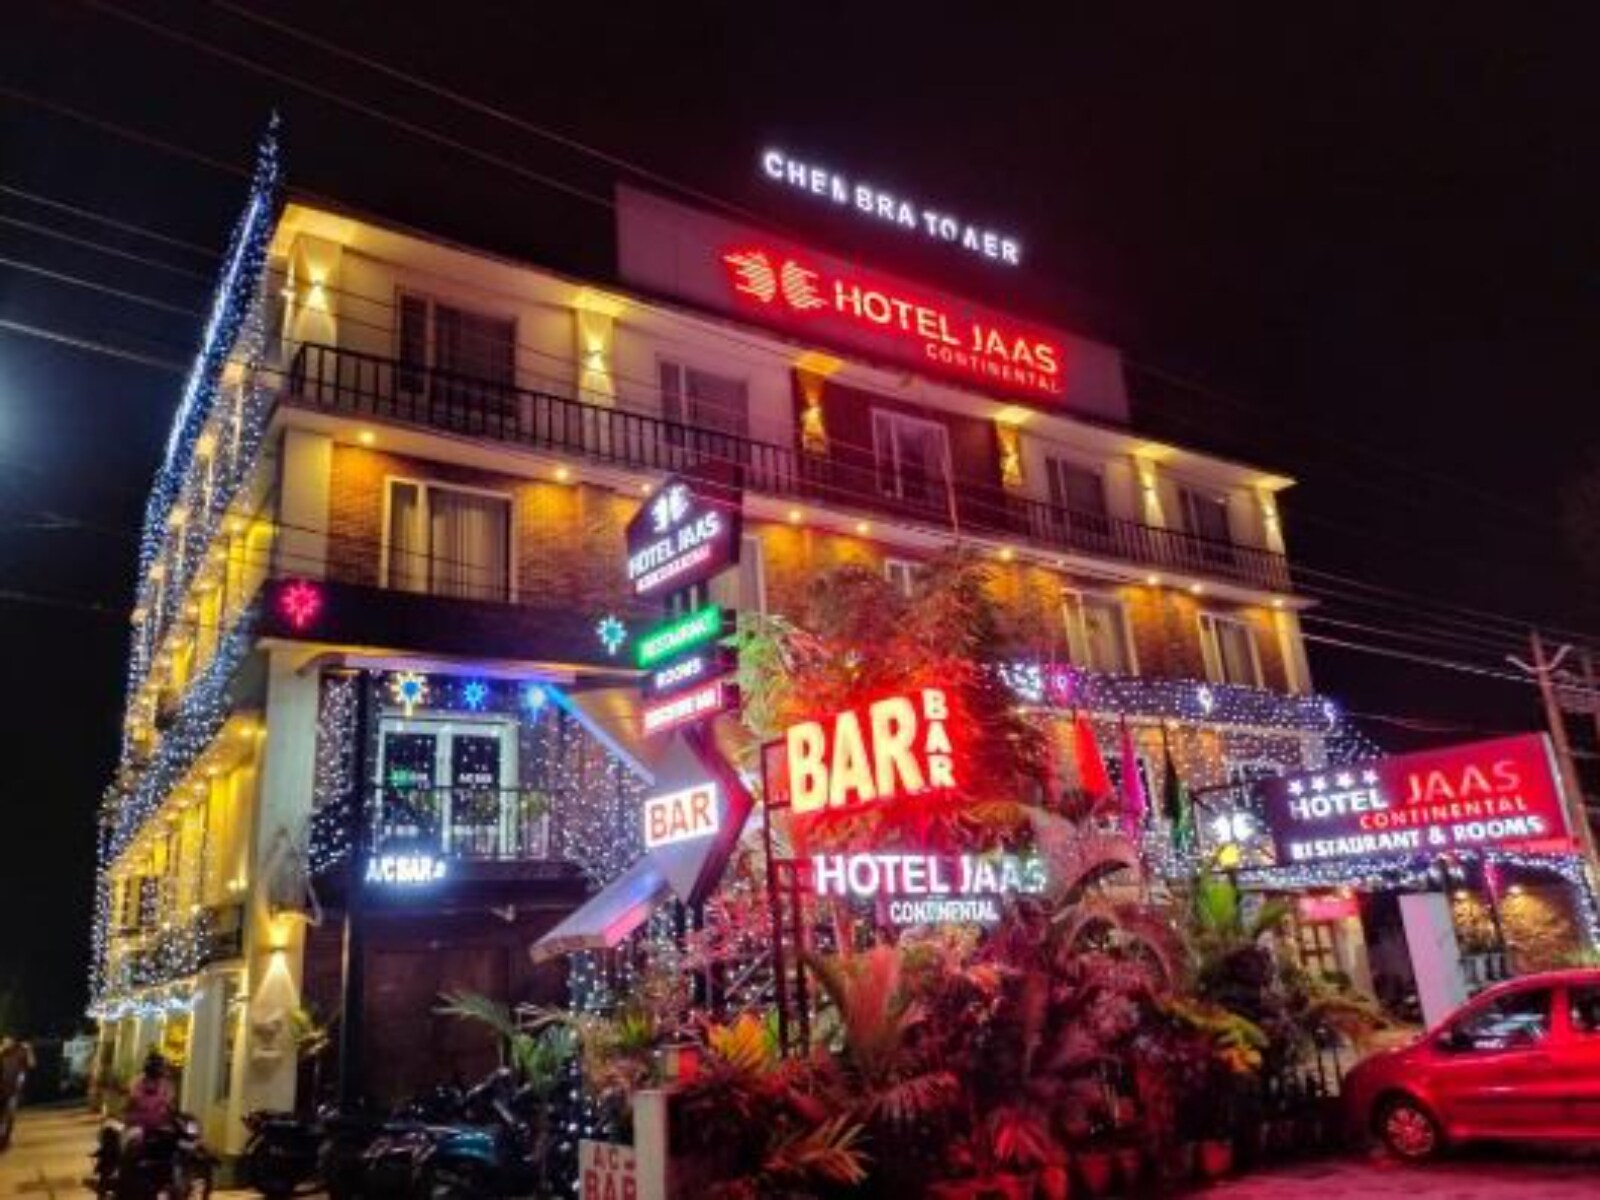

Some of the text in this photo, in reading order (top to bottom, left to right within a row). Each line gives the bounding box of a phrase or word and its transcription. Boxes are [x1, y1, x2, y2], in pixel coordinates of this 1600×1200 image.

[834, 280, 1058, 374] HOTEL JAAS
[925, 343, 1062, 394] CONTINENTAL
[628, 538, 676, 579] HOTEL
[678, 511, 719, 552] JAAS
[786, 695, 926, 814] BAR
[920, 687, 956, 787] BAR
[649, 791, 713, 839] BAR
[1289, 760, 1521, 820] HOTEL JAAS
[1359, 794, 1527, 829] CONTINENTAL
[1428, 825, 1447, 844] &
[1451, 815, 1545, 842] ROOMS
[813, 854, 1047, 895] HOTEL JAAS
[584, 1168, 637, 1200] BAR
